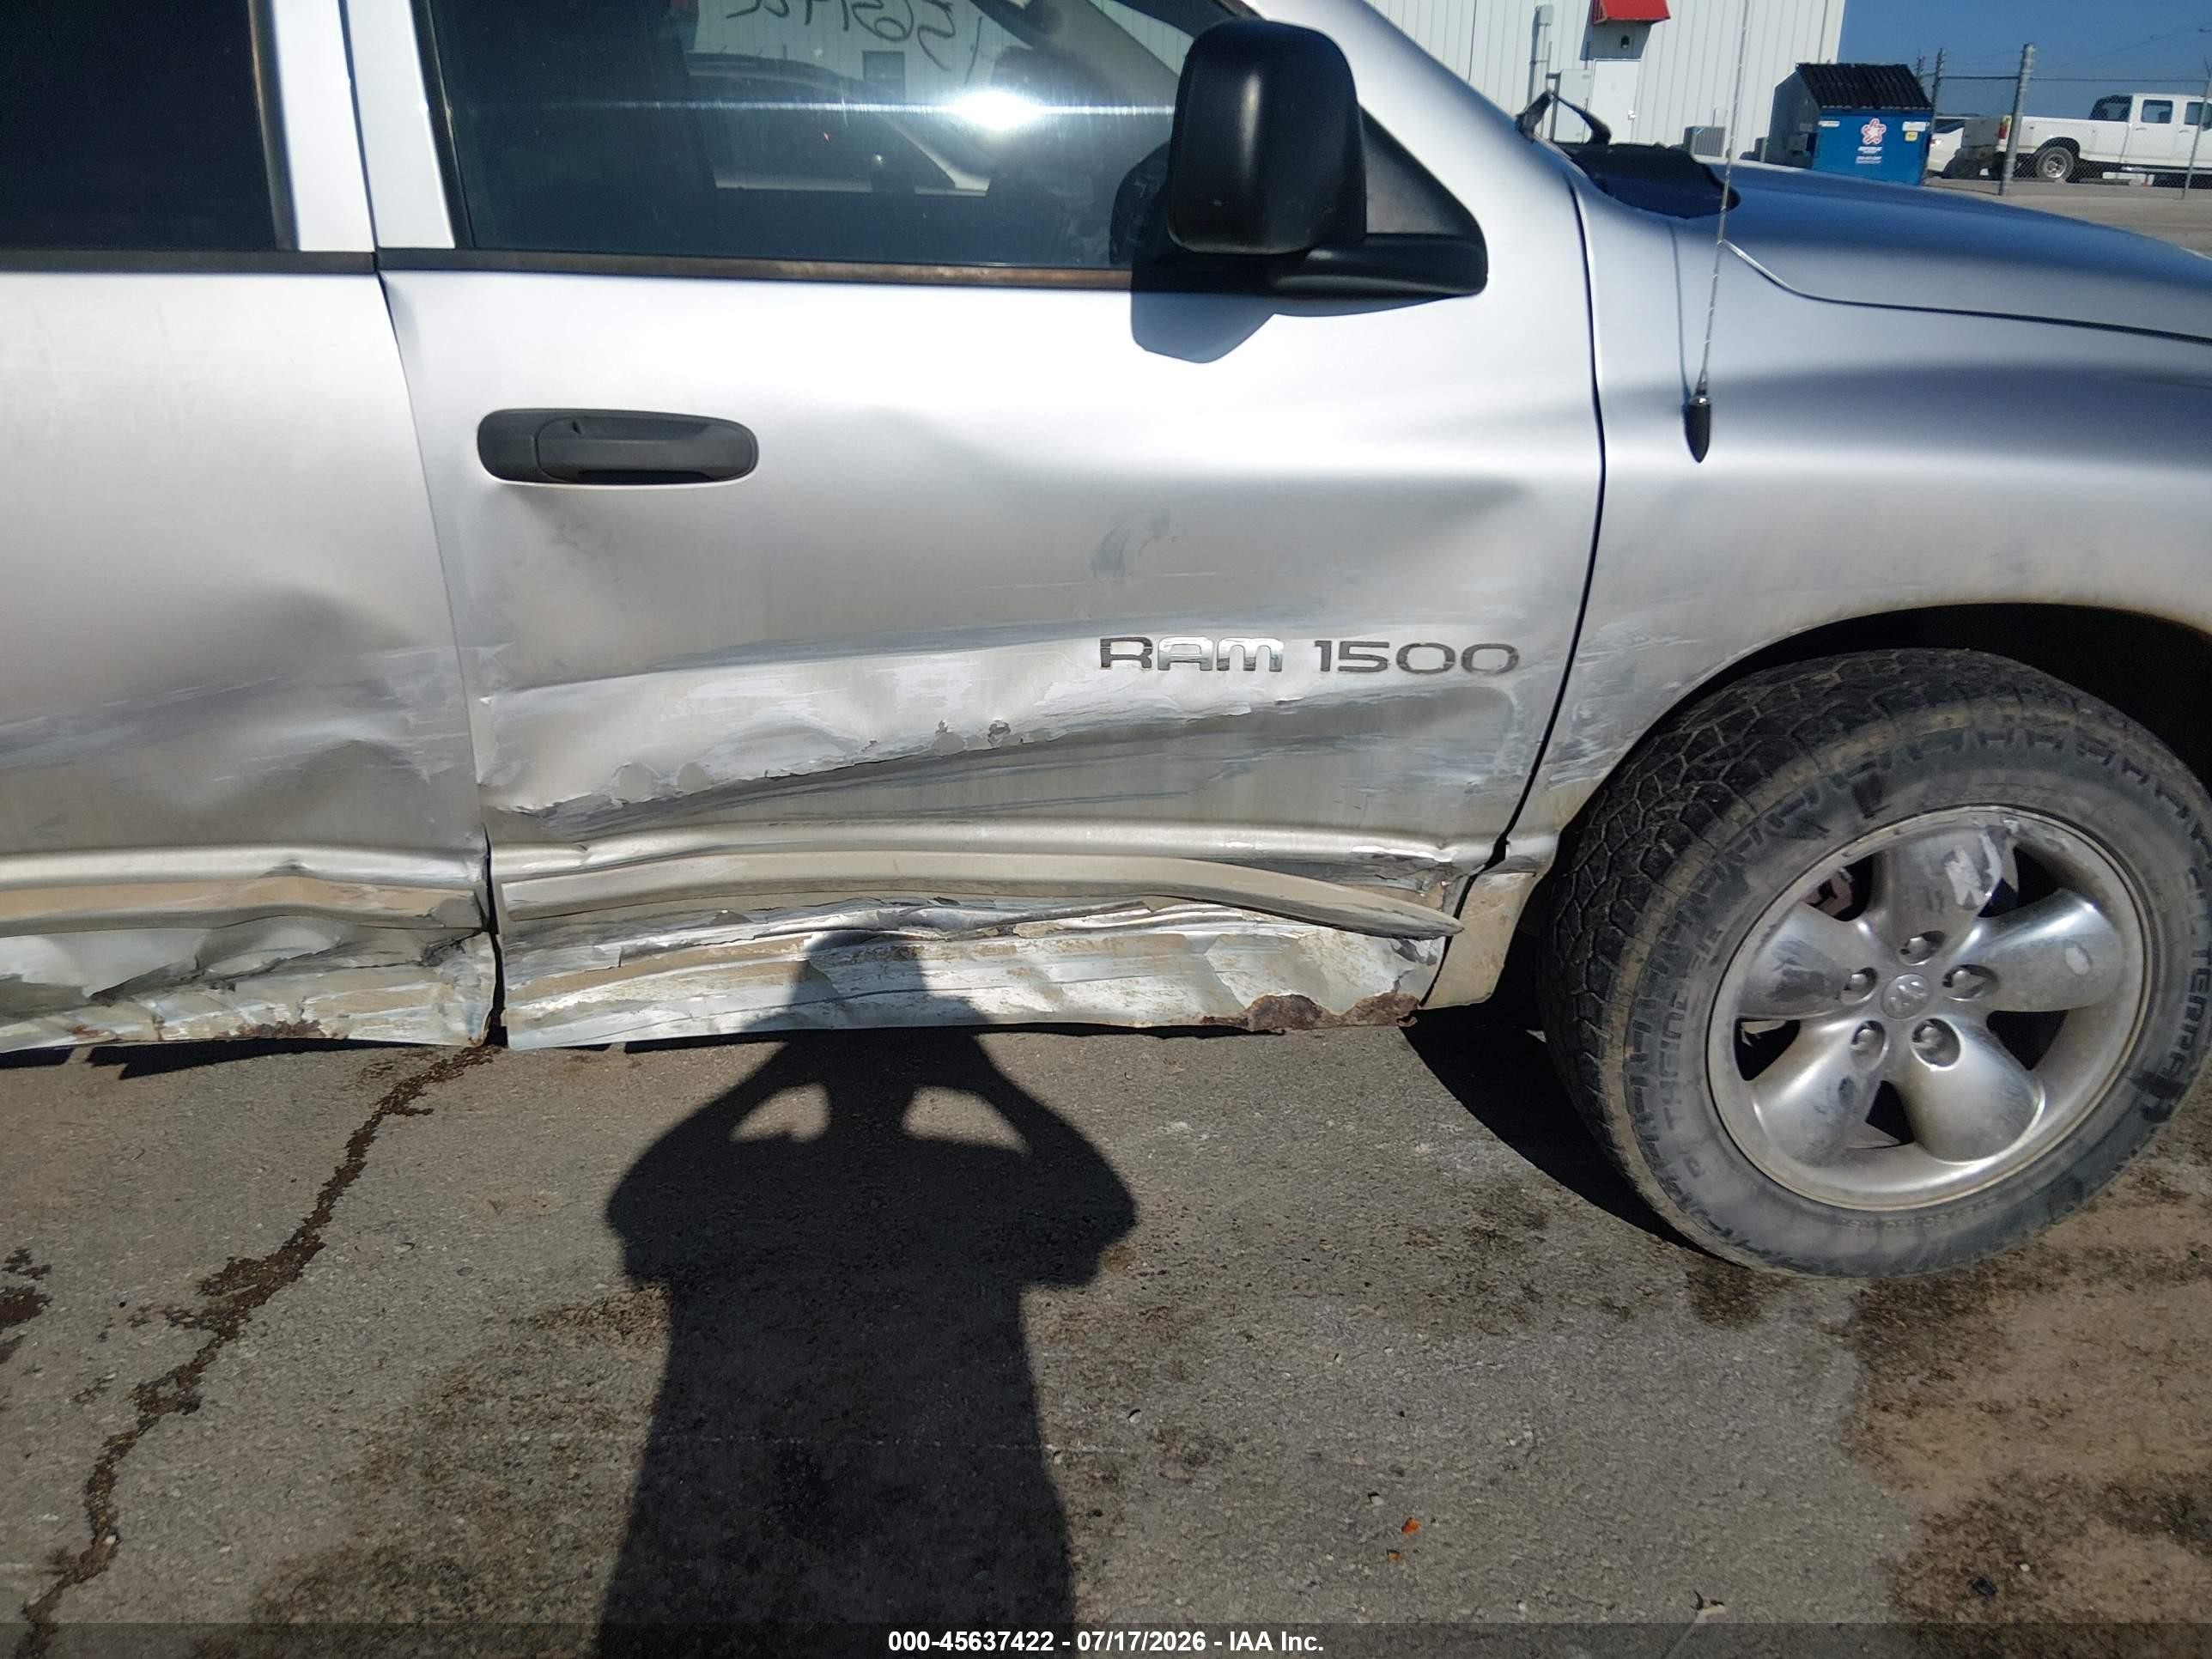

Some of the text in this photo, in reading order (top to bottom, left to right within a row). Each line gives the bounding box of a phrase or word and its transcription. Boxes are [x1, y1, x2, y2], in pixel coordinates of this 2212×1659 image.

[1100, 635, 1520, 675] RAM 1500
[1658, 926, 1723, 1180] PTHFINDER
